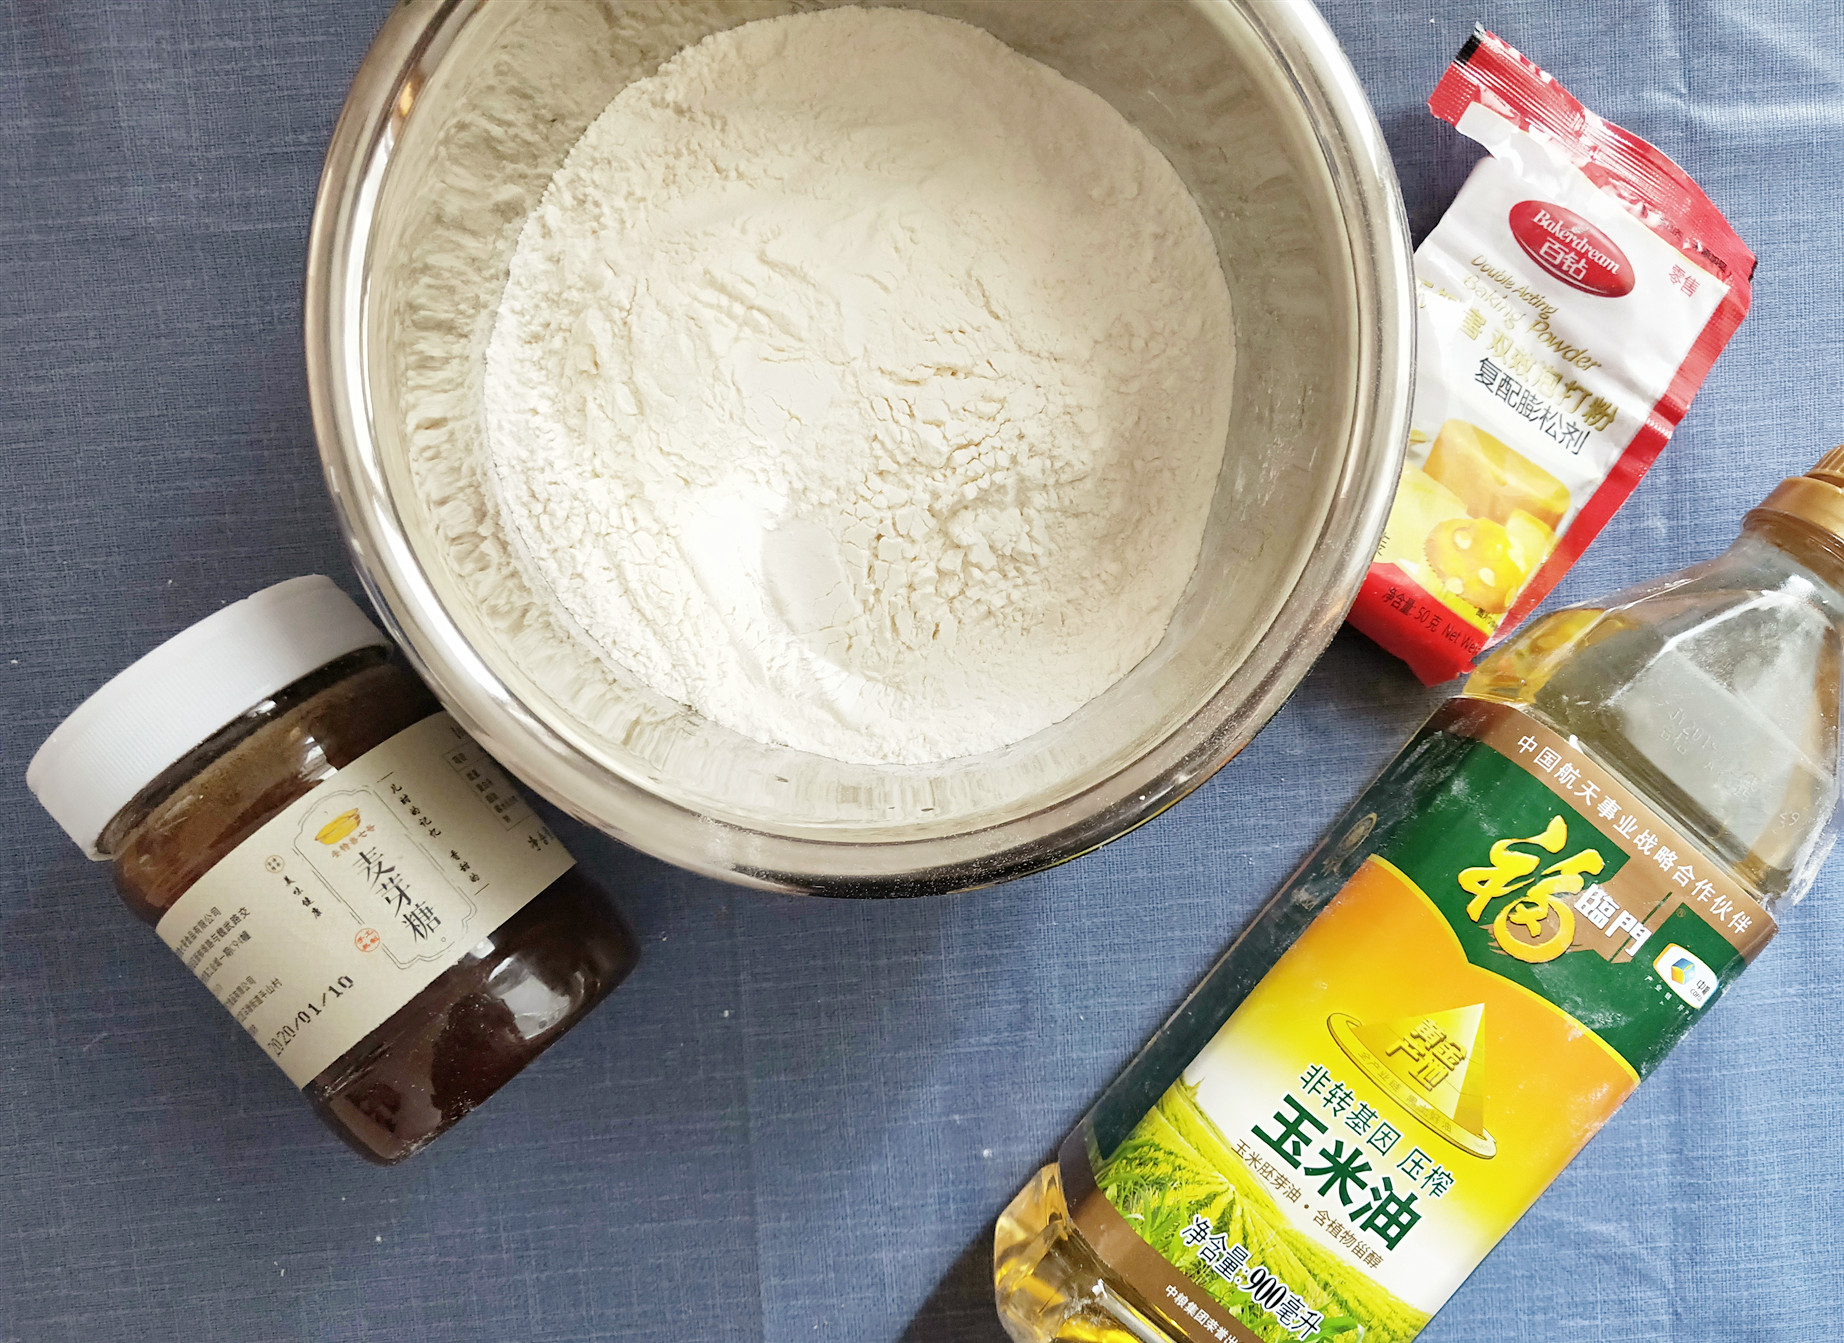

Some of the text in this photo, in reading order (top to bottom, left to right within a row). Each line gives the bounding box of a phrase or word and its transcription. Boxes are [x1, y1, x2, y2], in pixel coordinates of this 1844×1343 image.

[1532, 209, 1621, 276] Bakerdream
[1539, 238, 1588, 281] 百钻
[1667, 264, 1701, 298] 零售
[1463, 274, 1526, 331] Baking
[1529, 318, 1602, 371] Powder
[1470, 254, 1514, 294] Double
[1516, 284, 1559, 321] Acting
[1474, 357, 1591, 455] 复配膨松剂
[1414, 606, 1431, 623] 50
[1425, 614, 1443, 633] 克
[1442, 623, 1461, 643] Net
[390, 783, 441, 838] 儿时的记忆
[1516, 733, 1753, 934] 中国航天事业战略合作伙伴
[352, 846, 442, 944] 麦芽糖
[267, 975, 354, 1057] 2020/01/10
[1410, 1017, 1467, 1071] 黄金
[1250, 1093, 1422, 1251] 玉米油
[1299, 1063, 1456, 1199] 非转基因 压榨
[1231, 1139, 1384, 1269] 玉米胚芽油 含植物甾醇
